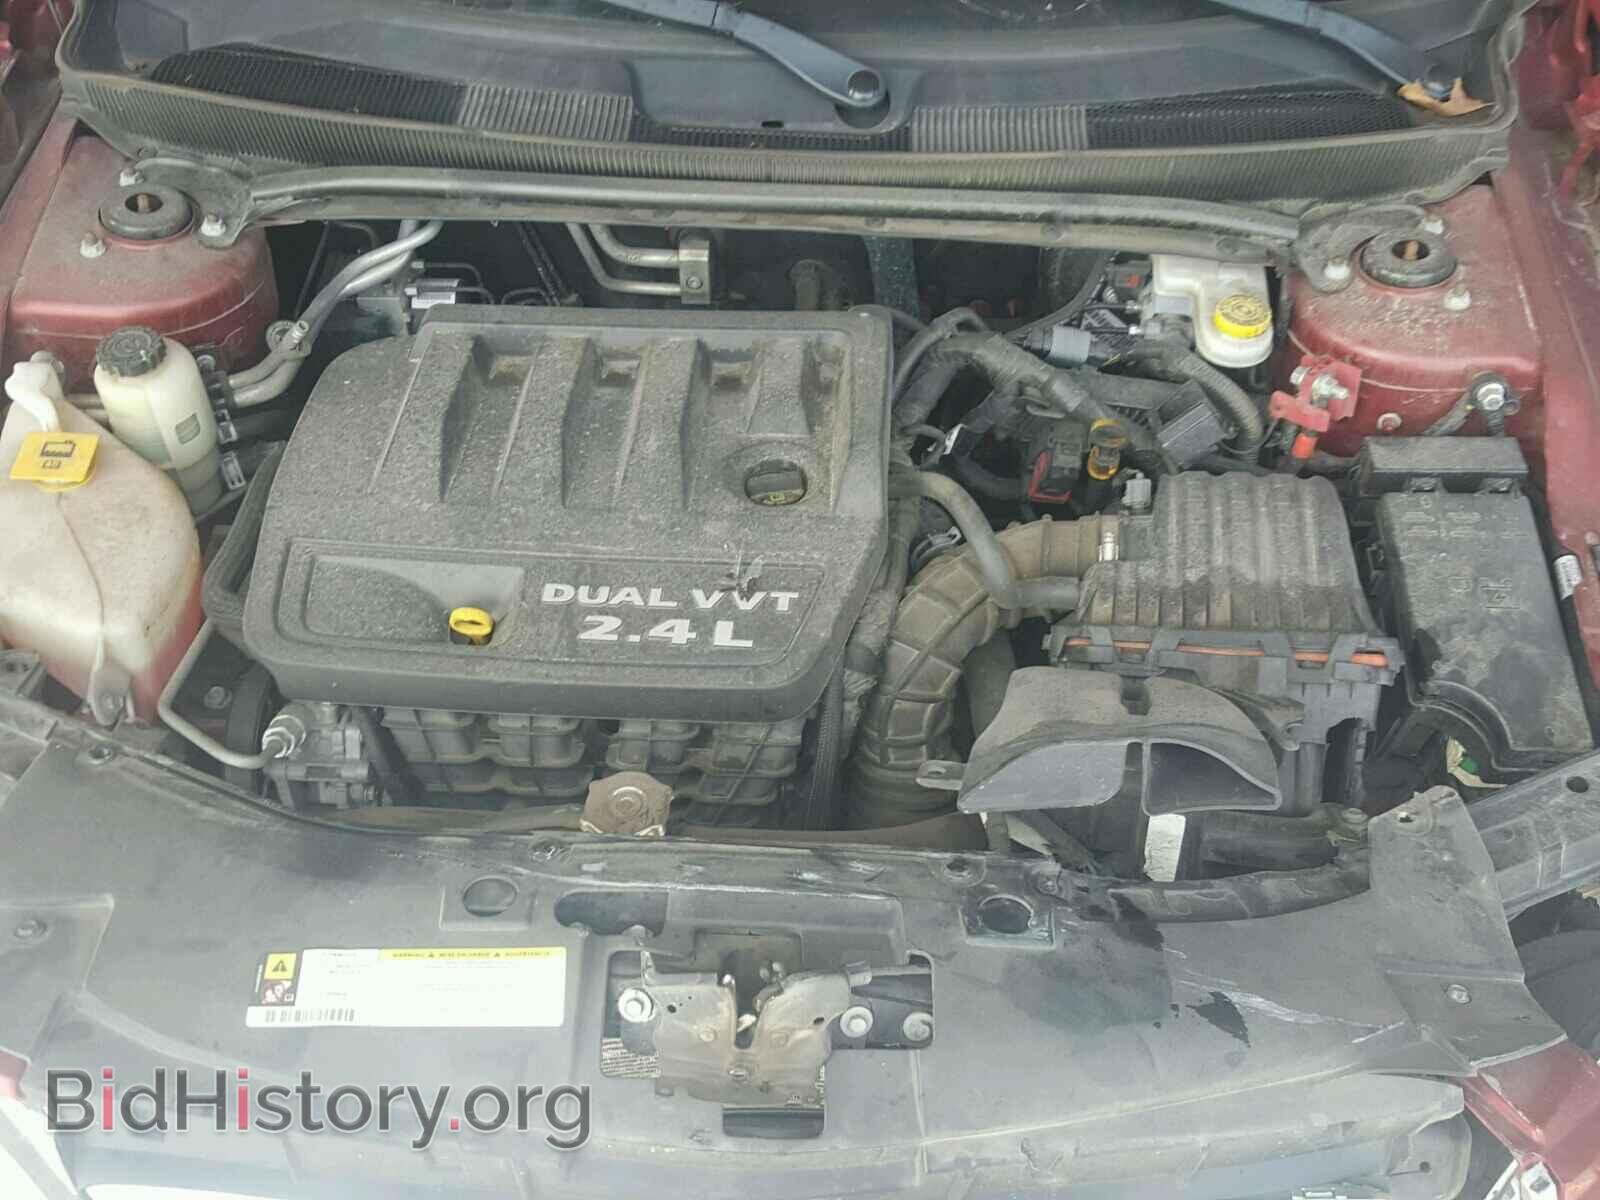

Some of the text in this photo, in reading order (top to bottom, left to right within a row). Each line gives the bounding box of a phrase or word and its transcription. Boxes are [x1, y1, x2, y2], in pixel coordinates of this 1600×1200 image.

[541, 583, 800, 612] DUAL VVT
[578, 614, 755, 648] 2.4 L
